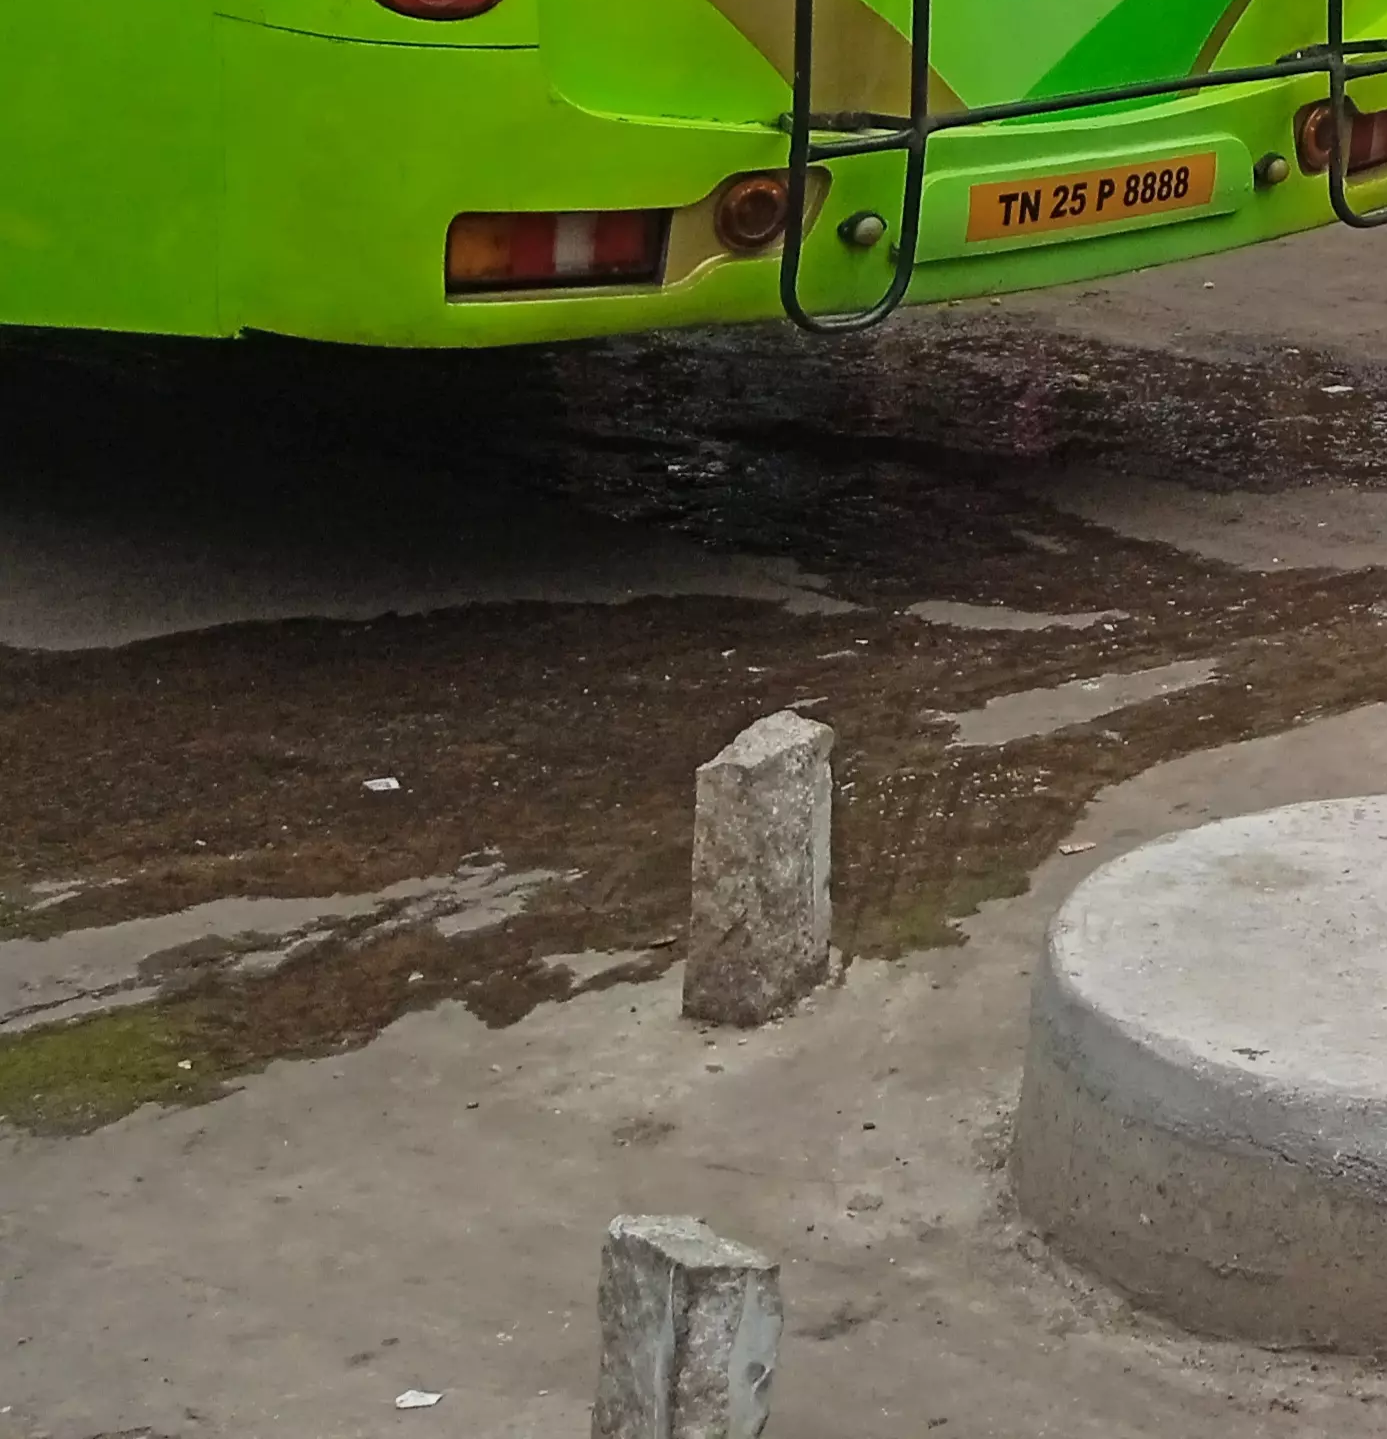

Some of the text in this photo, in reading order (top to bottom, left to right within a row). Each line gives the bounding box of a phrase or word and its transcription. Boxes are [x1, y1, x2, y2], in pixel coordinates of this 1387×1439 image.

[998, 166, 1189, 226] TN 25 P 8888
